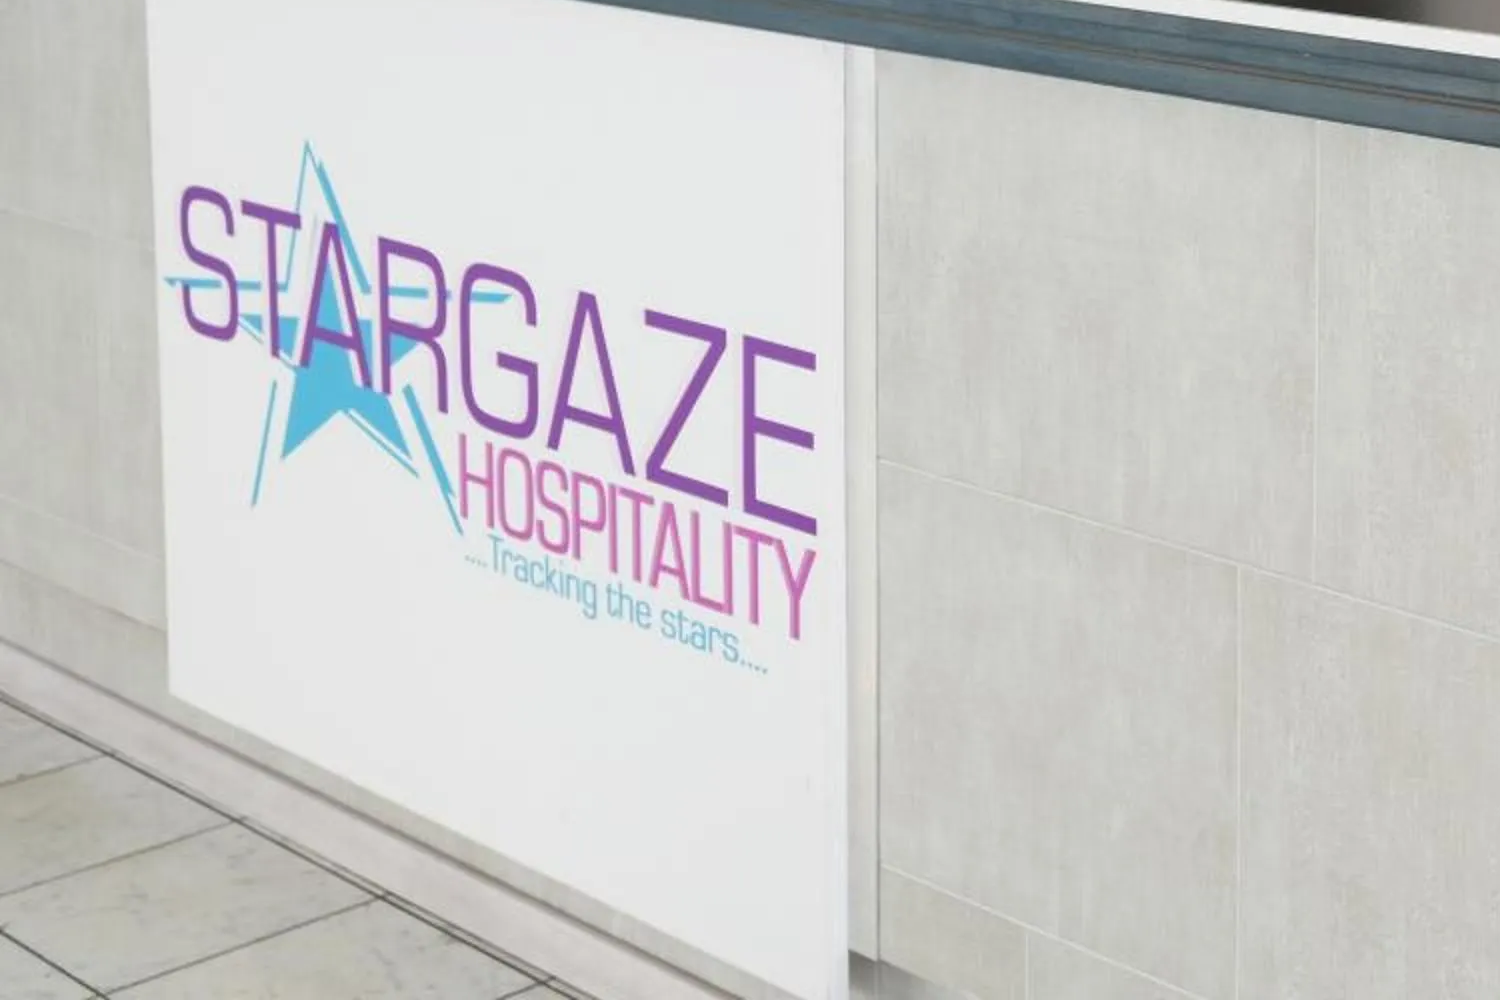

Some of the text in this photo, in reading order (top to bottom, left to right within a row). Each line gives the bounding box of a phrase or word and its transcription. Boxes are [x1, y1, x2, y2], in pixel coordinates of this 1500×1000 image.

[179, 185, 817, 536] STARGAZE
[459, 433, 817, 641] HOSPITALITY
[605, 584, 652, 631] the
